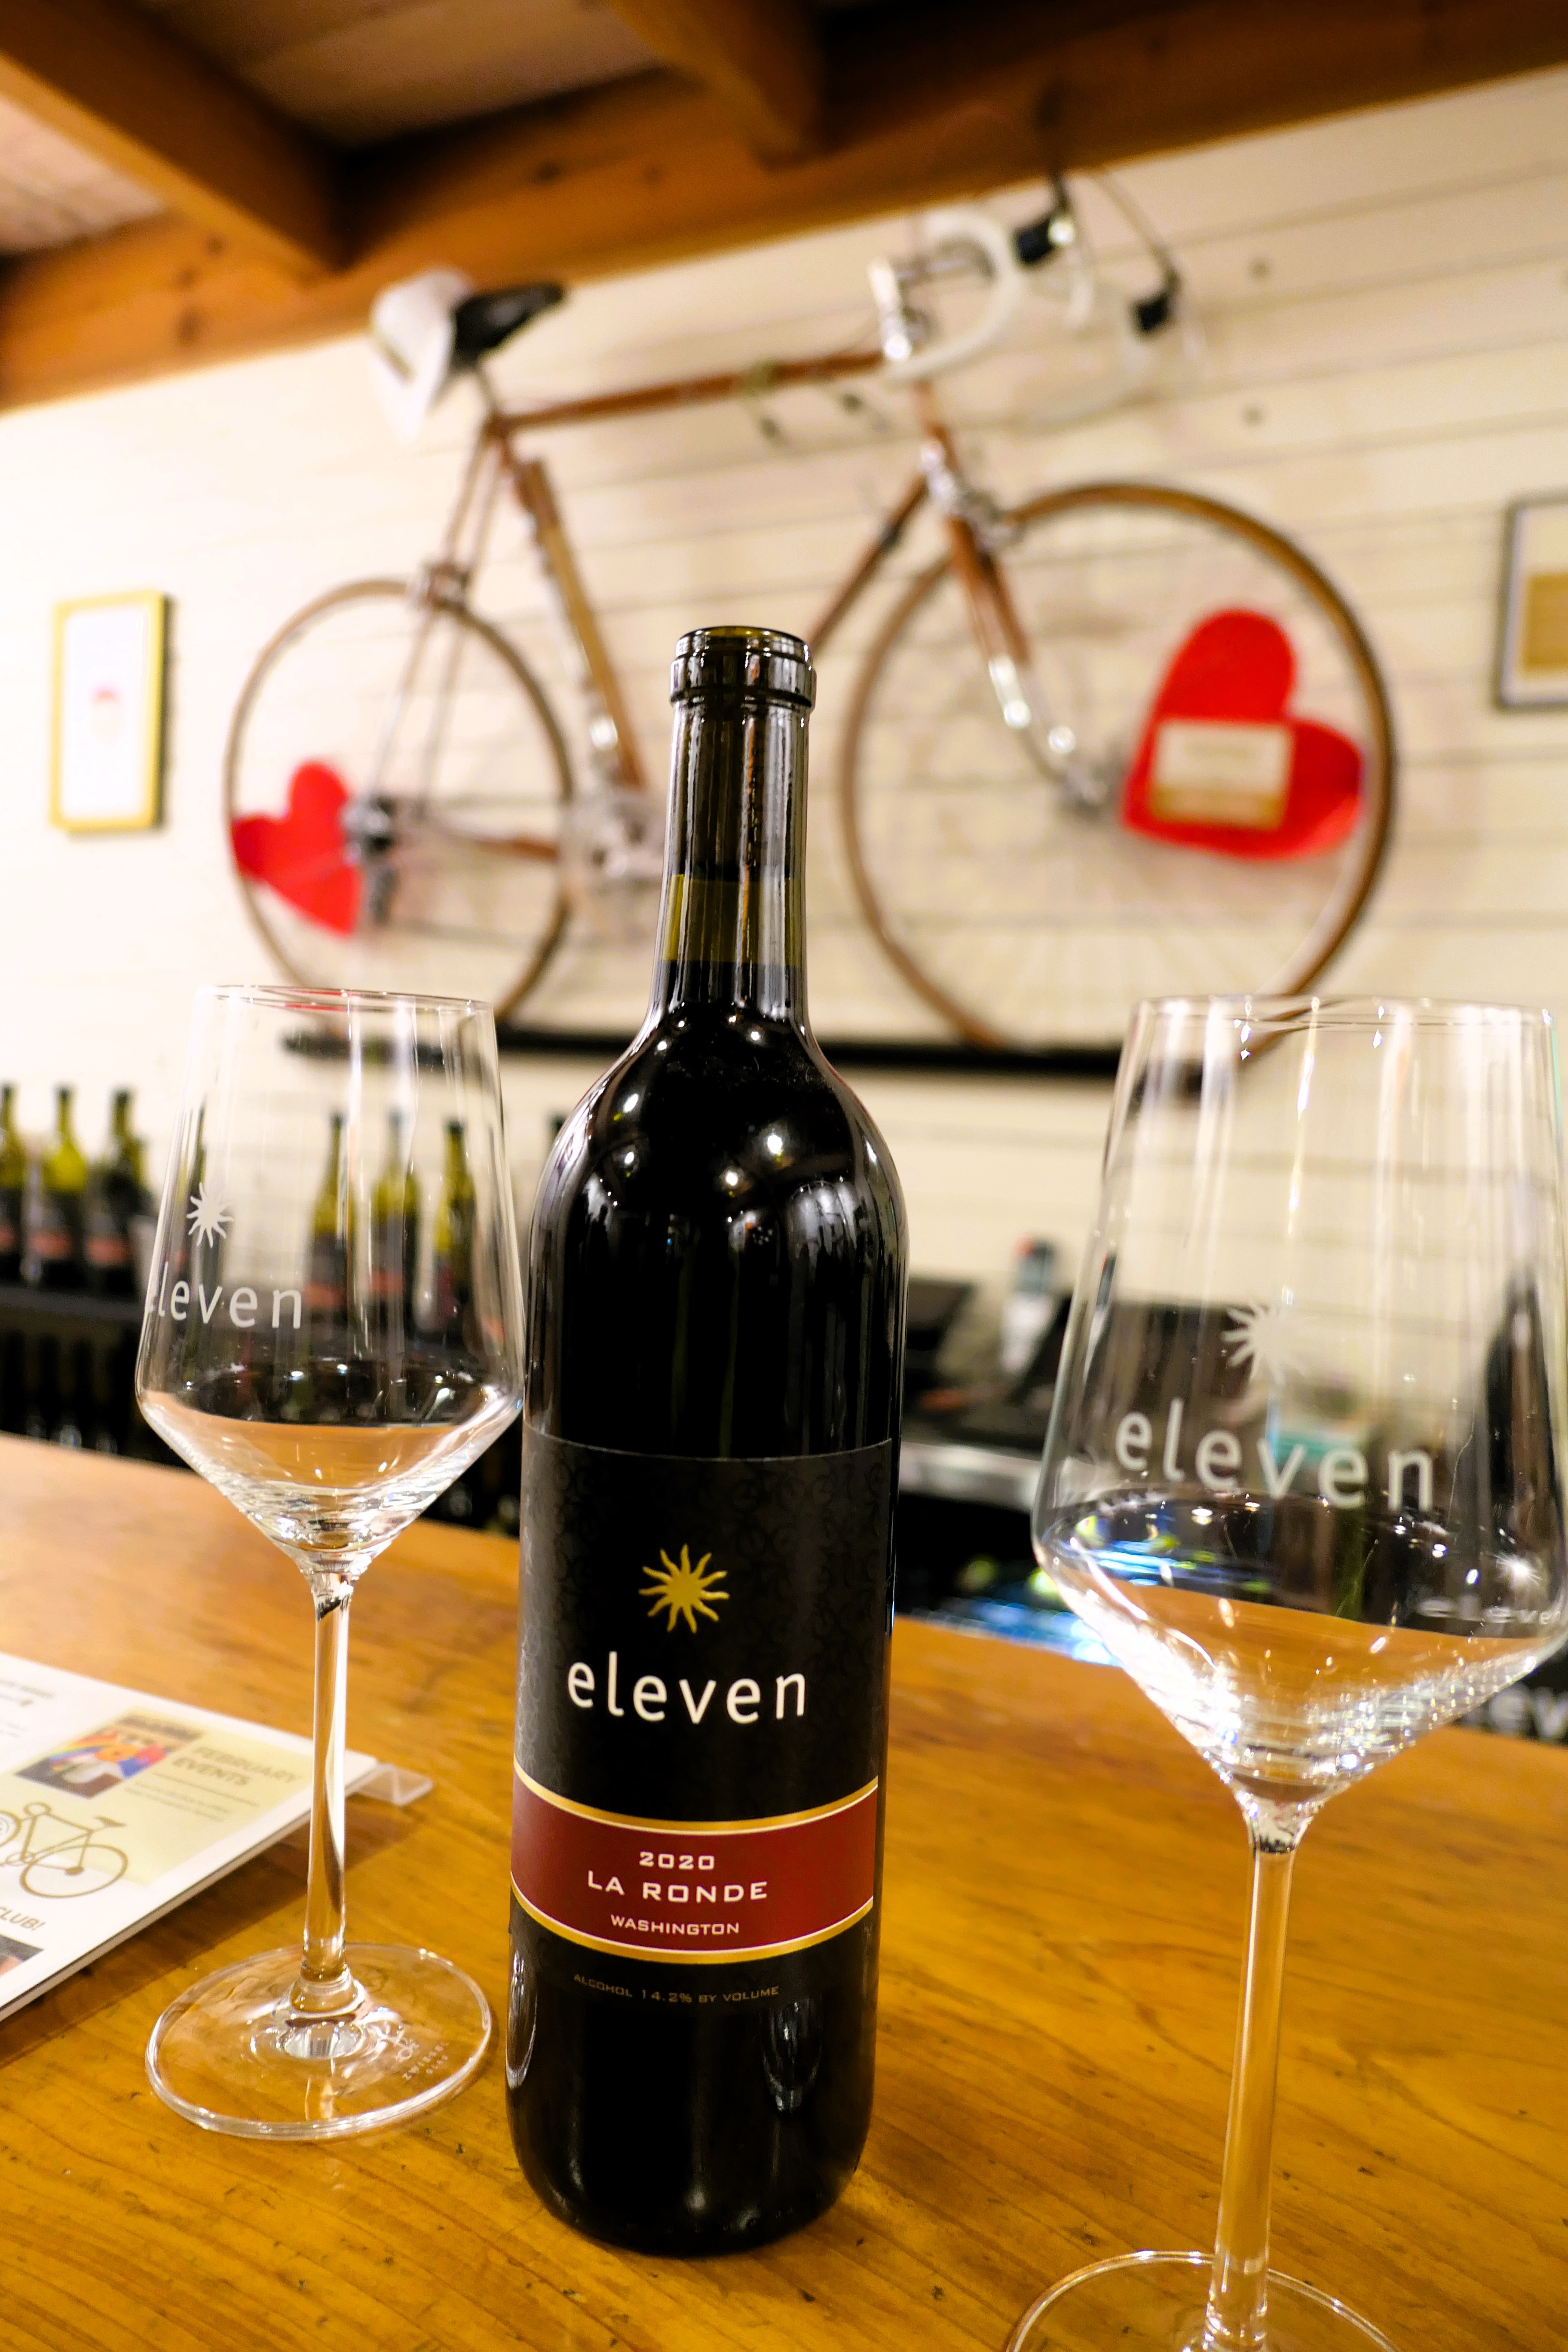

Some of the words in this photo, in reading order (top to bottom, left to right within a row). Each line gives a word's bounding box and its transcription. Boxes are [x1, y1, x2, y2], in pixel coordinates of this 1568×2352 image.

[148, 1261, 302, 1329] leven
[1116, 1396, 1433, 1512] eleven
[567, 1651, 805, 1724] eleven
[639, 1851, 715, 1871] 2020
[588, 1870, 625, 1896] LA
[642, 1880, 768, 1903] RONDE
[610, 1914, 740, 1936] WASHINGTON
[573, 1973, 633, 1998] ALCOHOL
[641, 1989, 692, 2003] 14.2%
[698, 1994, 717, 2003] BY
[723, 1985, 780, 2002] VOLUME
